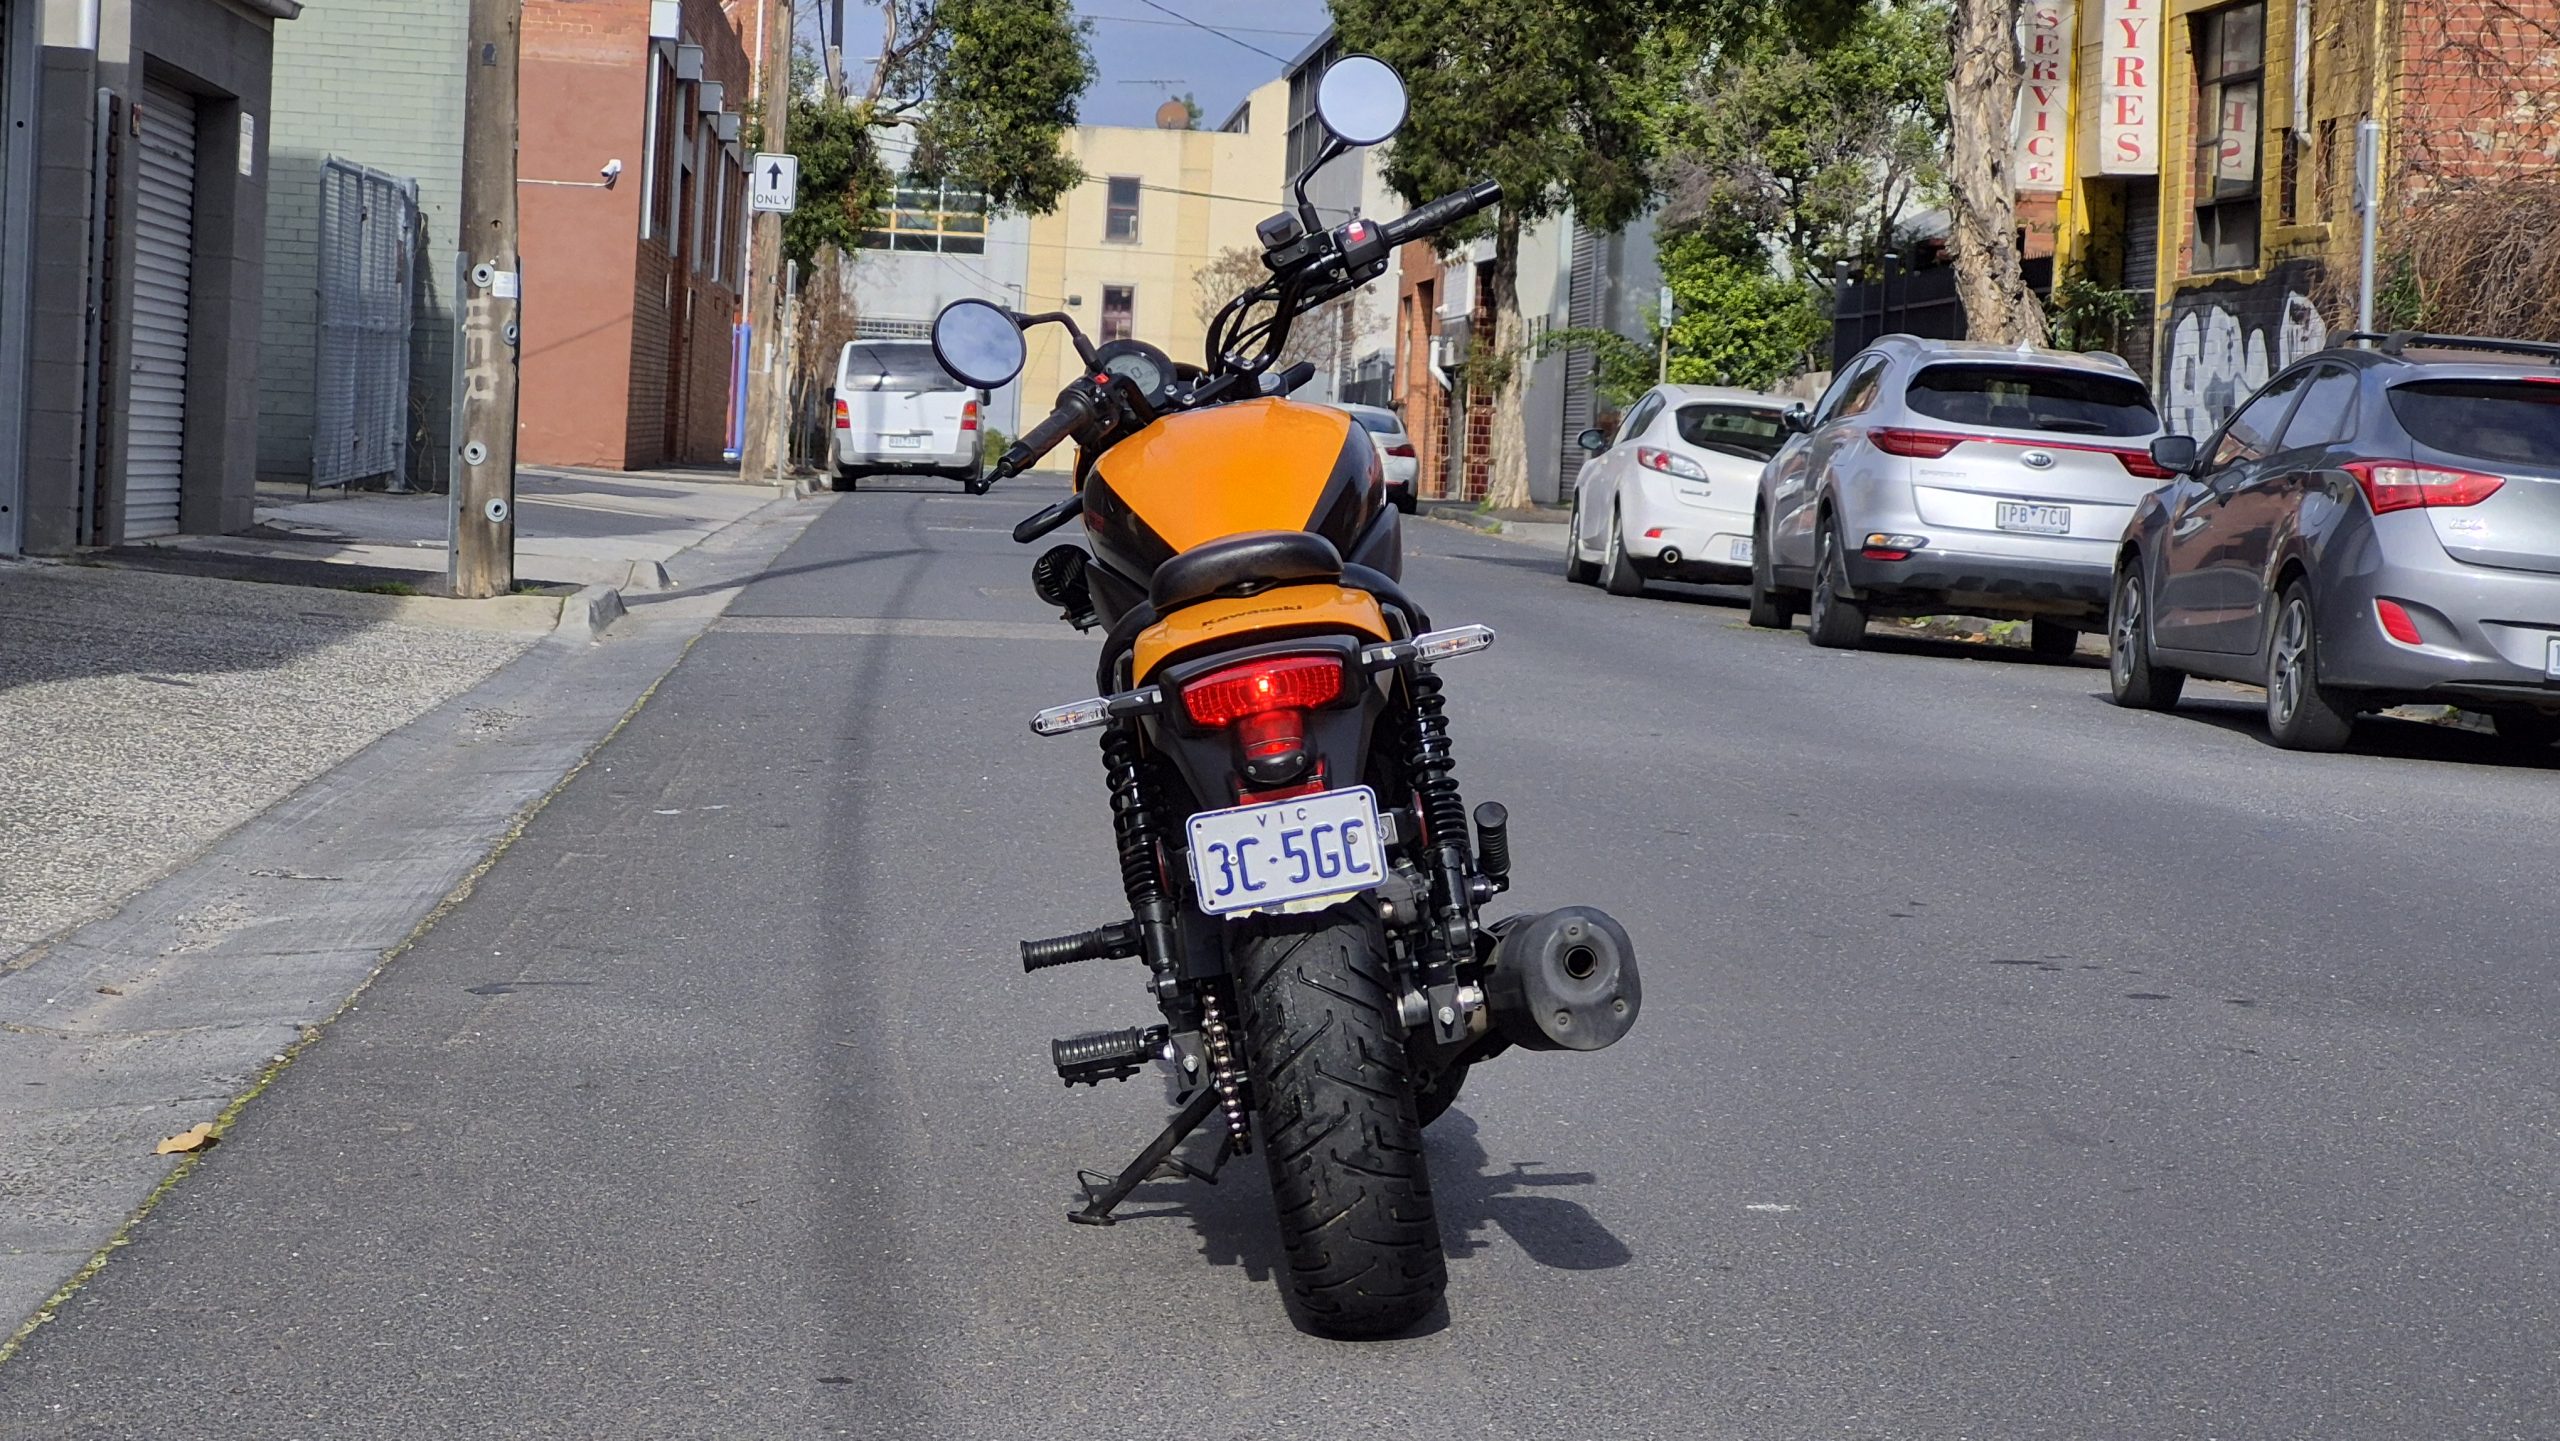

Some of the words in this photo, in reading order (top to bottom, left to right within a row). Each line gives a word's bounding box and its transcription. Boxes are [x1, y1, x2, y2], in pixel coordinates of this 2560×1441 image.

[2027, 9, 2059, 182] SERVICE
[756, 194, 790, 205] ONLY
[2002, 506, 2028, 523] 1PB
[2040, 508, 2068, 526] 7CU
[1202, 605, 1302, 626] Kawasaki
[1256, 808, 1307, 827] VIC
